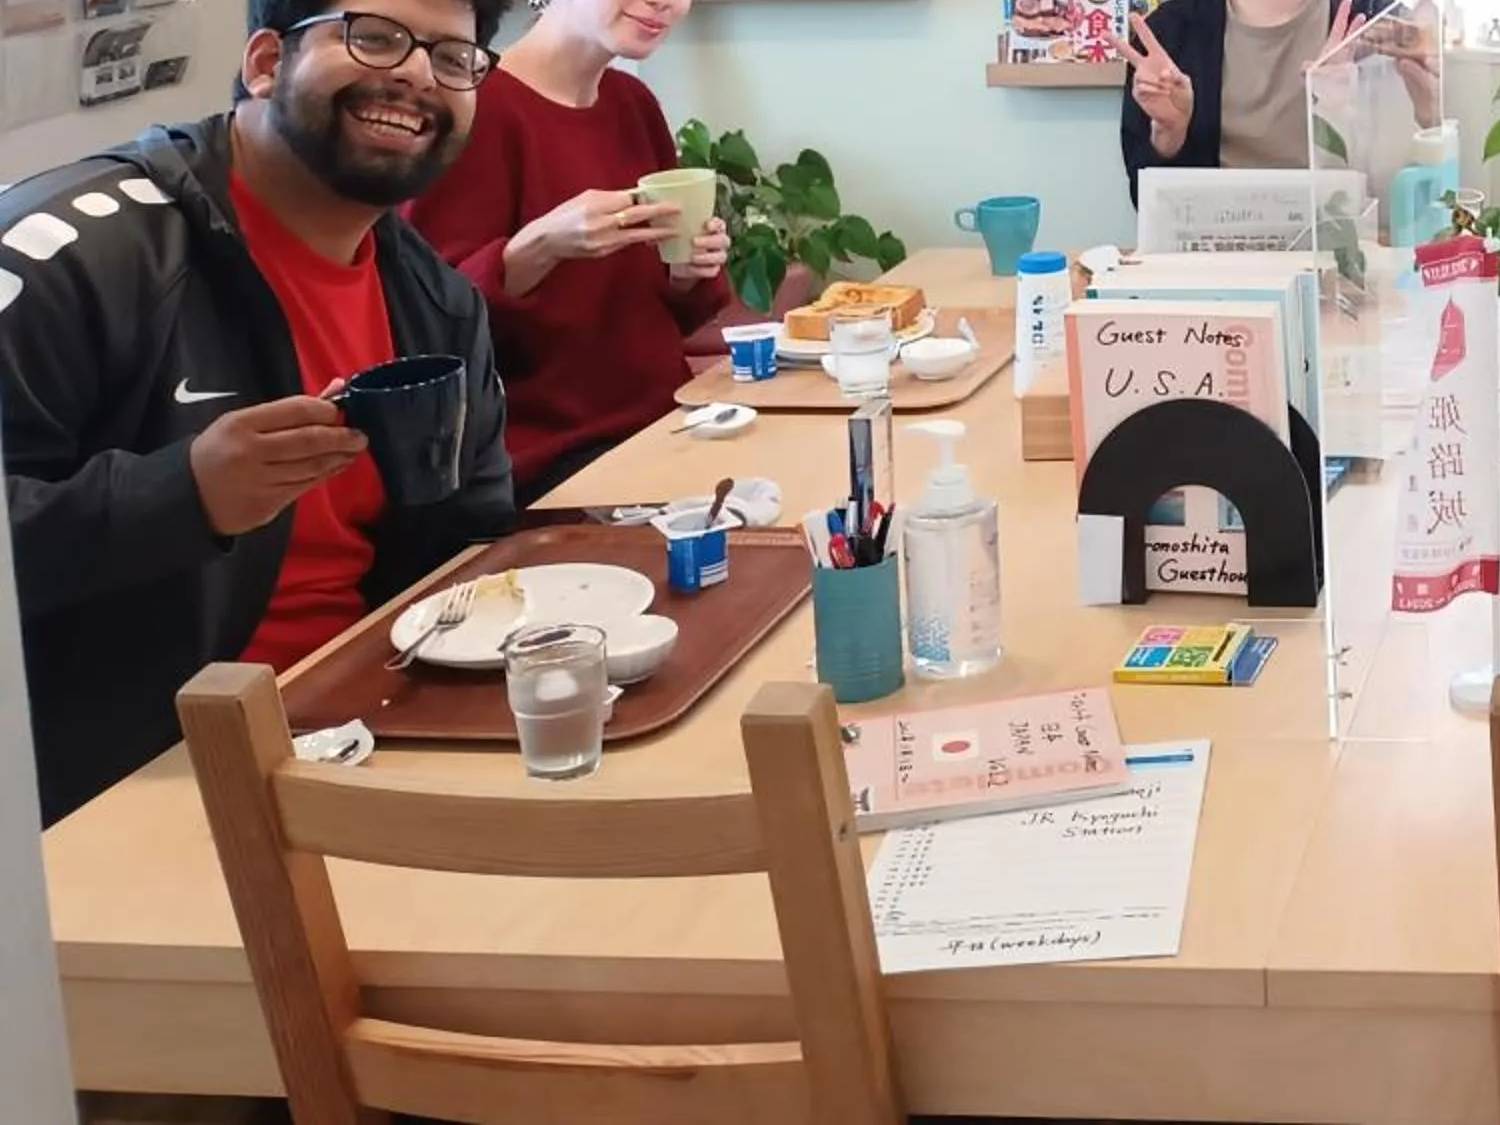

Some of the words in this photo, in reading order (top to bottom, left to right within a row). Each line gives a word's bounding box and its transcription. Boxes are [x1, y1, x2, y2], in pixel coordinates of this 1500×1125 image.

[1096, 320, 1168, 347] Guest
[1183, 321, 1245, 348] Notes
[1104, 366, 1225, 399] U.S.A.
[1157, 557, 1249, 584] Guesthou
